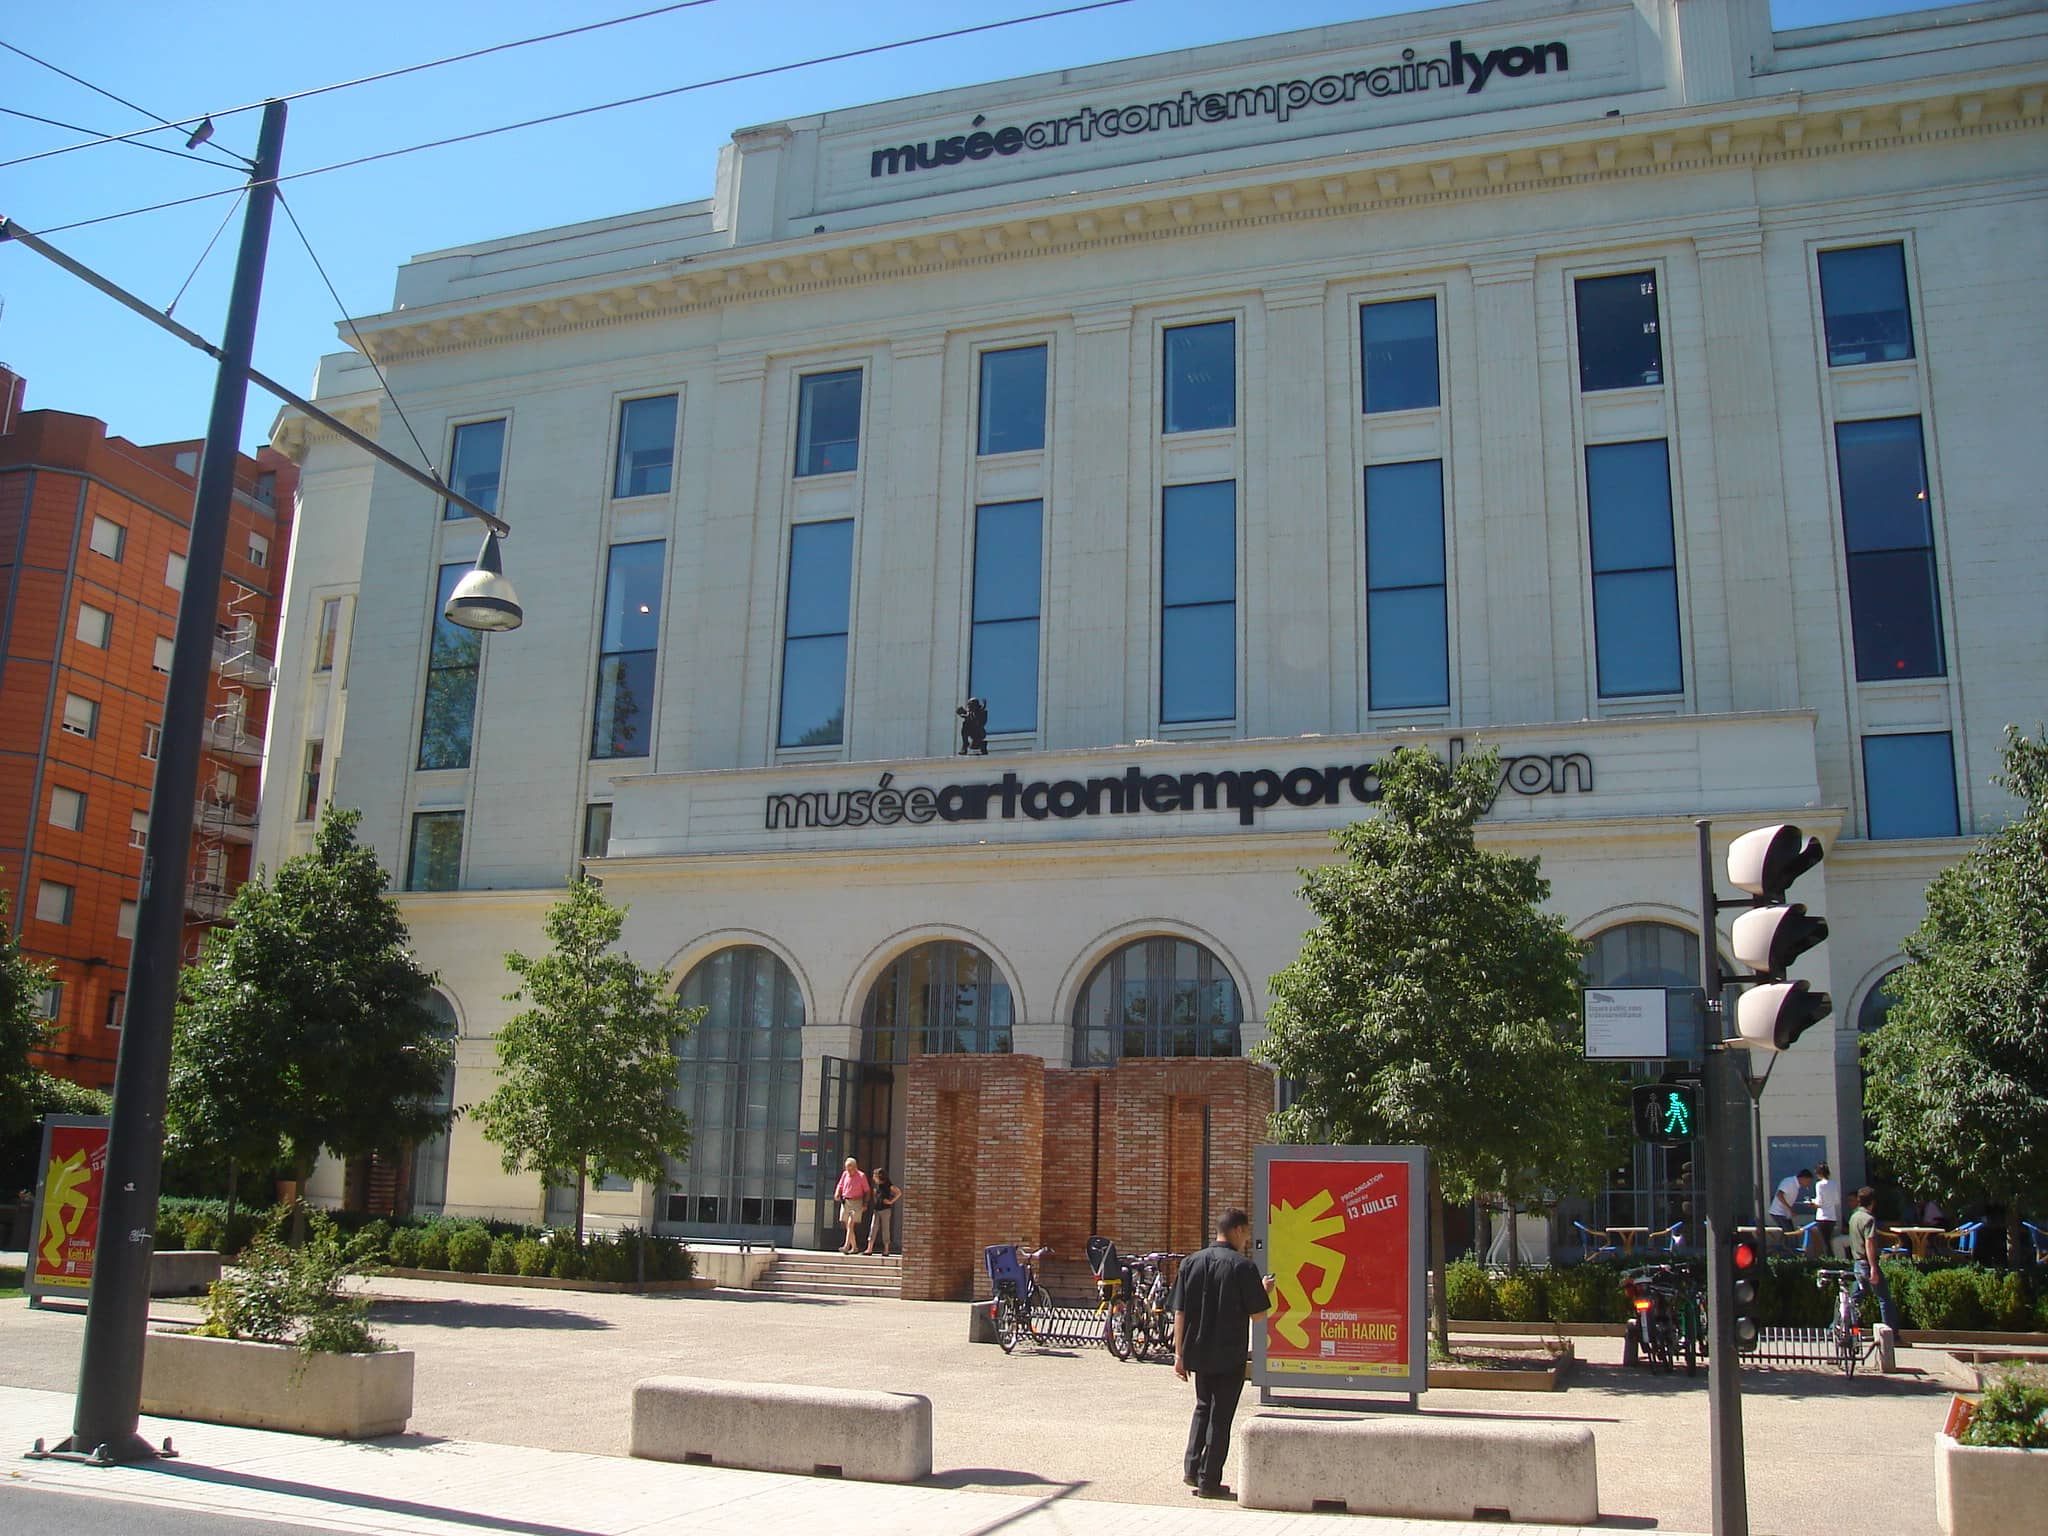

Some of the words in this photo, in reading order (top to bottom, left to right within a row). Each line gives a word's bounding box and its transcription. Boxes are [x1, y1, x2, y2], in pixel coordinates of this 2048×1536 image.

[1347, 1206, 1359, 1220] 13
[1361, 1194, 1398, 1216] JUILLET
[1320, 1308, 1358, 1322] Exposition
[1320, 1321, 1348, 1339] Keith
[1352, 1322, 1397, 1341] HARING
